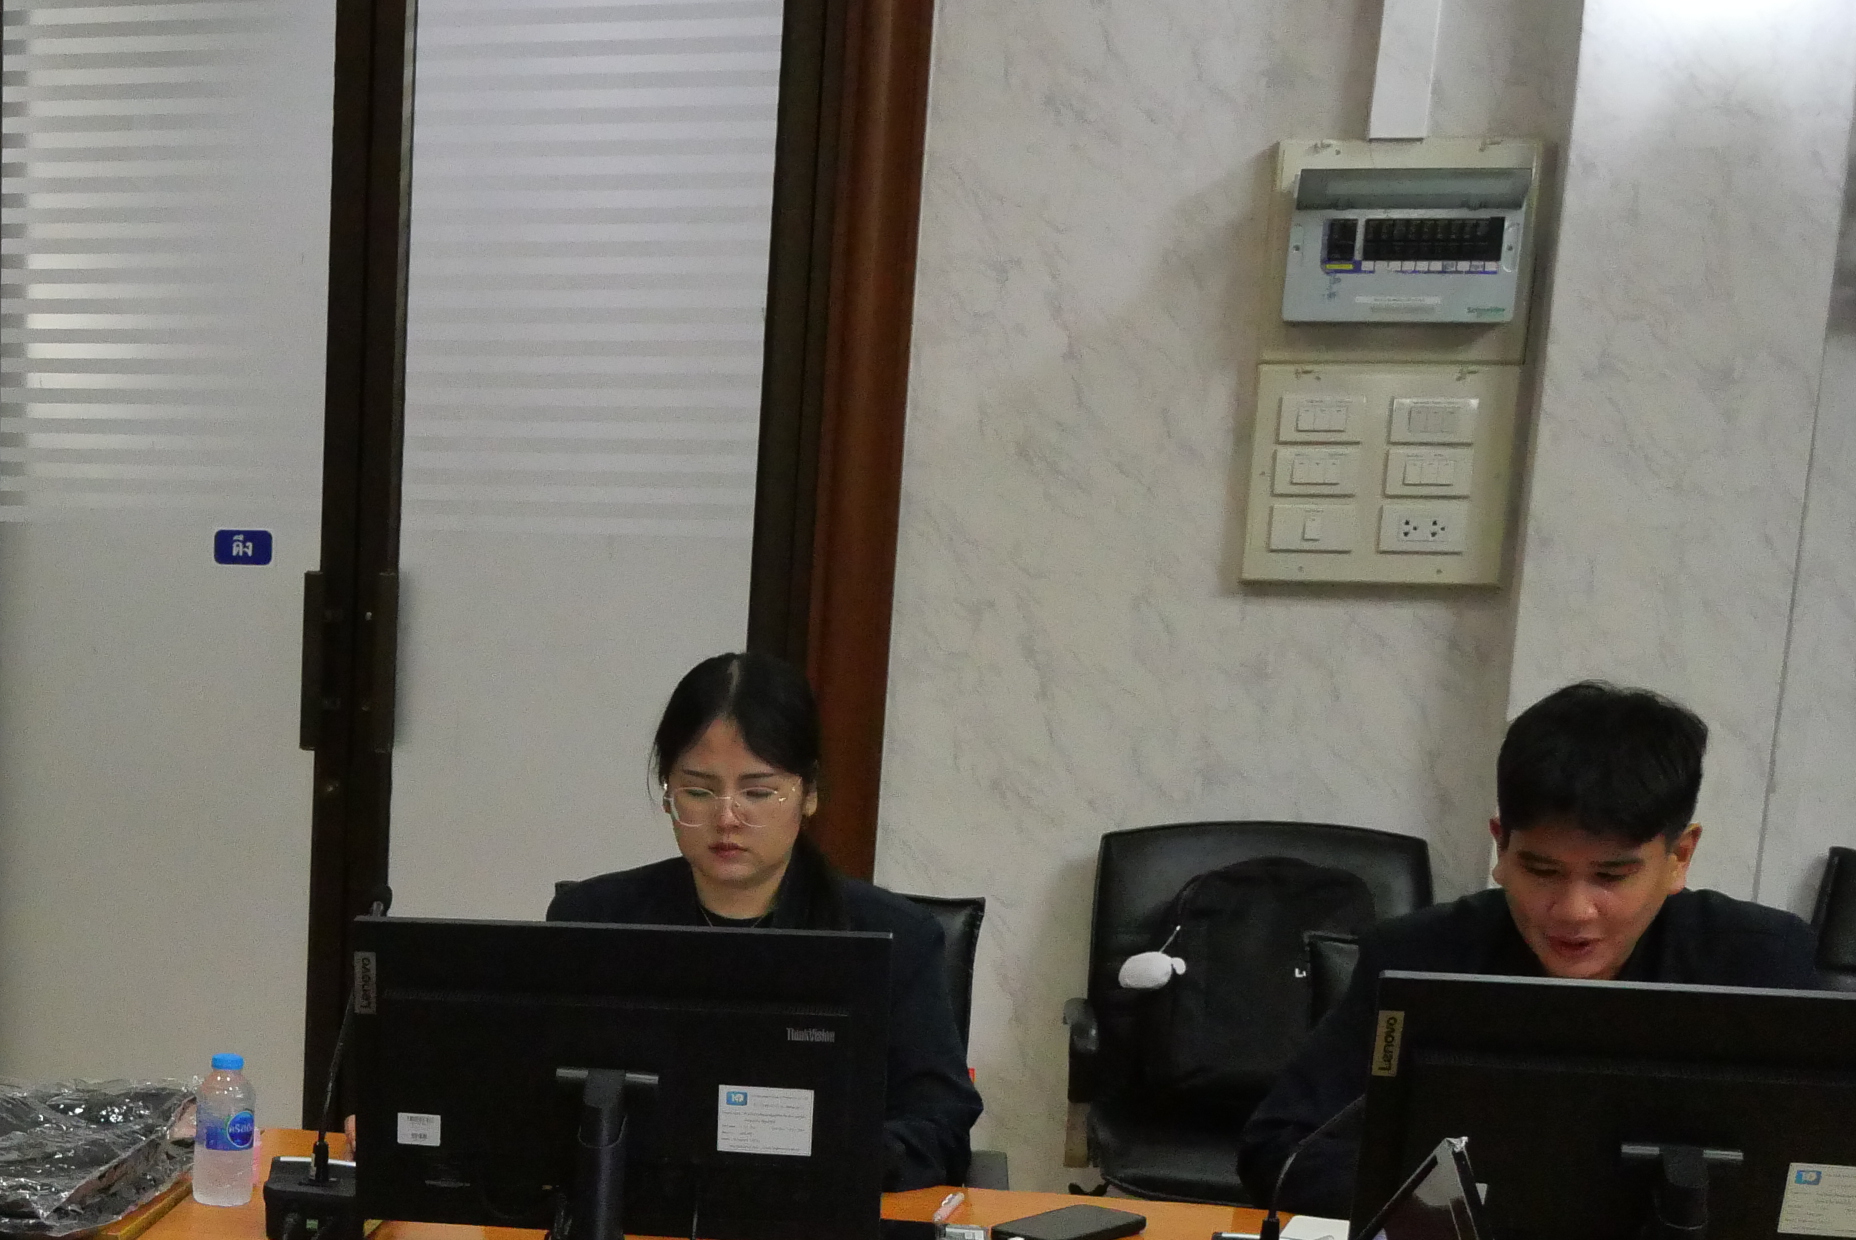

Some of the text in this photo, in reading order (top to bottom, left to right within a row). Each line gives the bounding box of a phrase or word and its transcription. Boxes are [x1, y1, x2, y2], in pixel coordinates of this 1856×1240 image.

[232, 534, 253, 557] ดึง
[786, 1027, 835, 1043] ThinkVision
[1378, 1016, 1397, 1071] Lenovo
